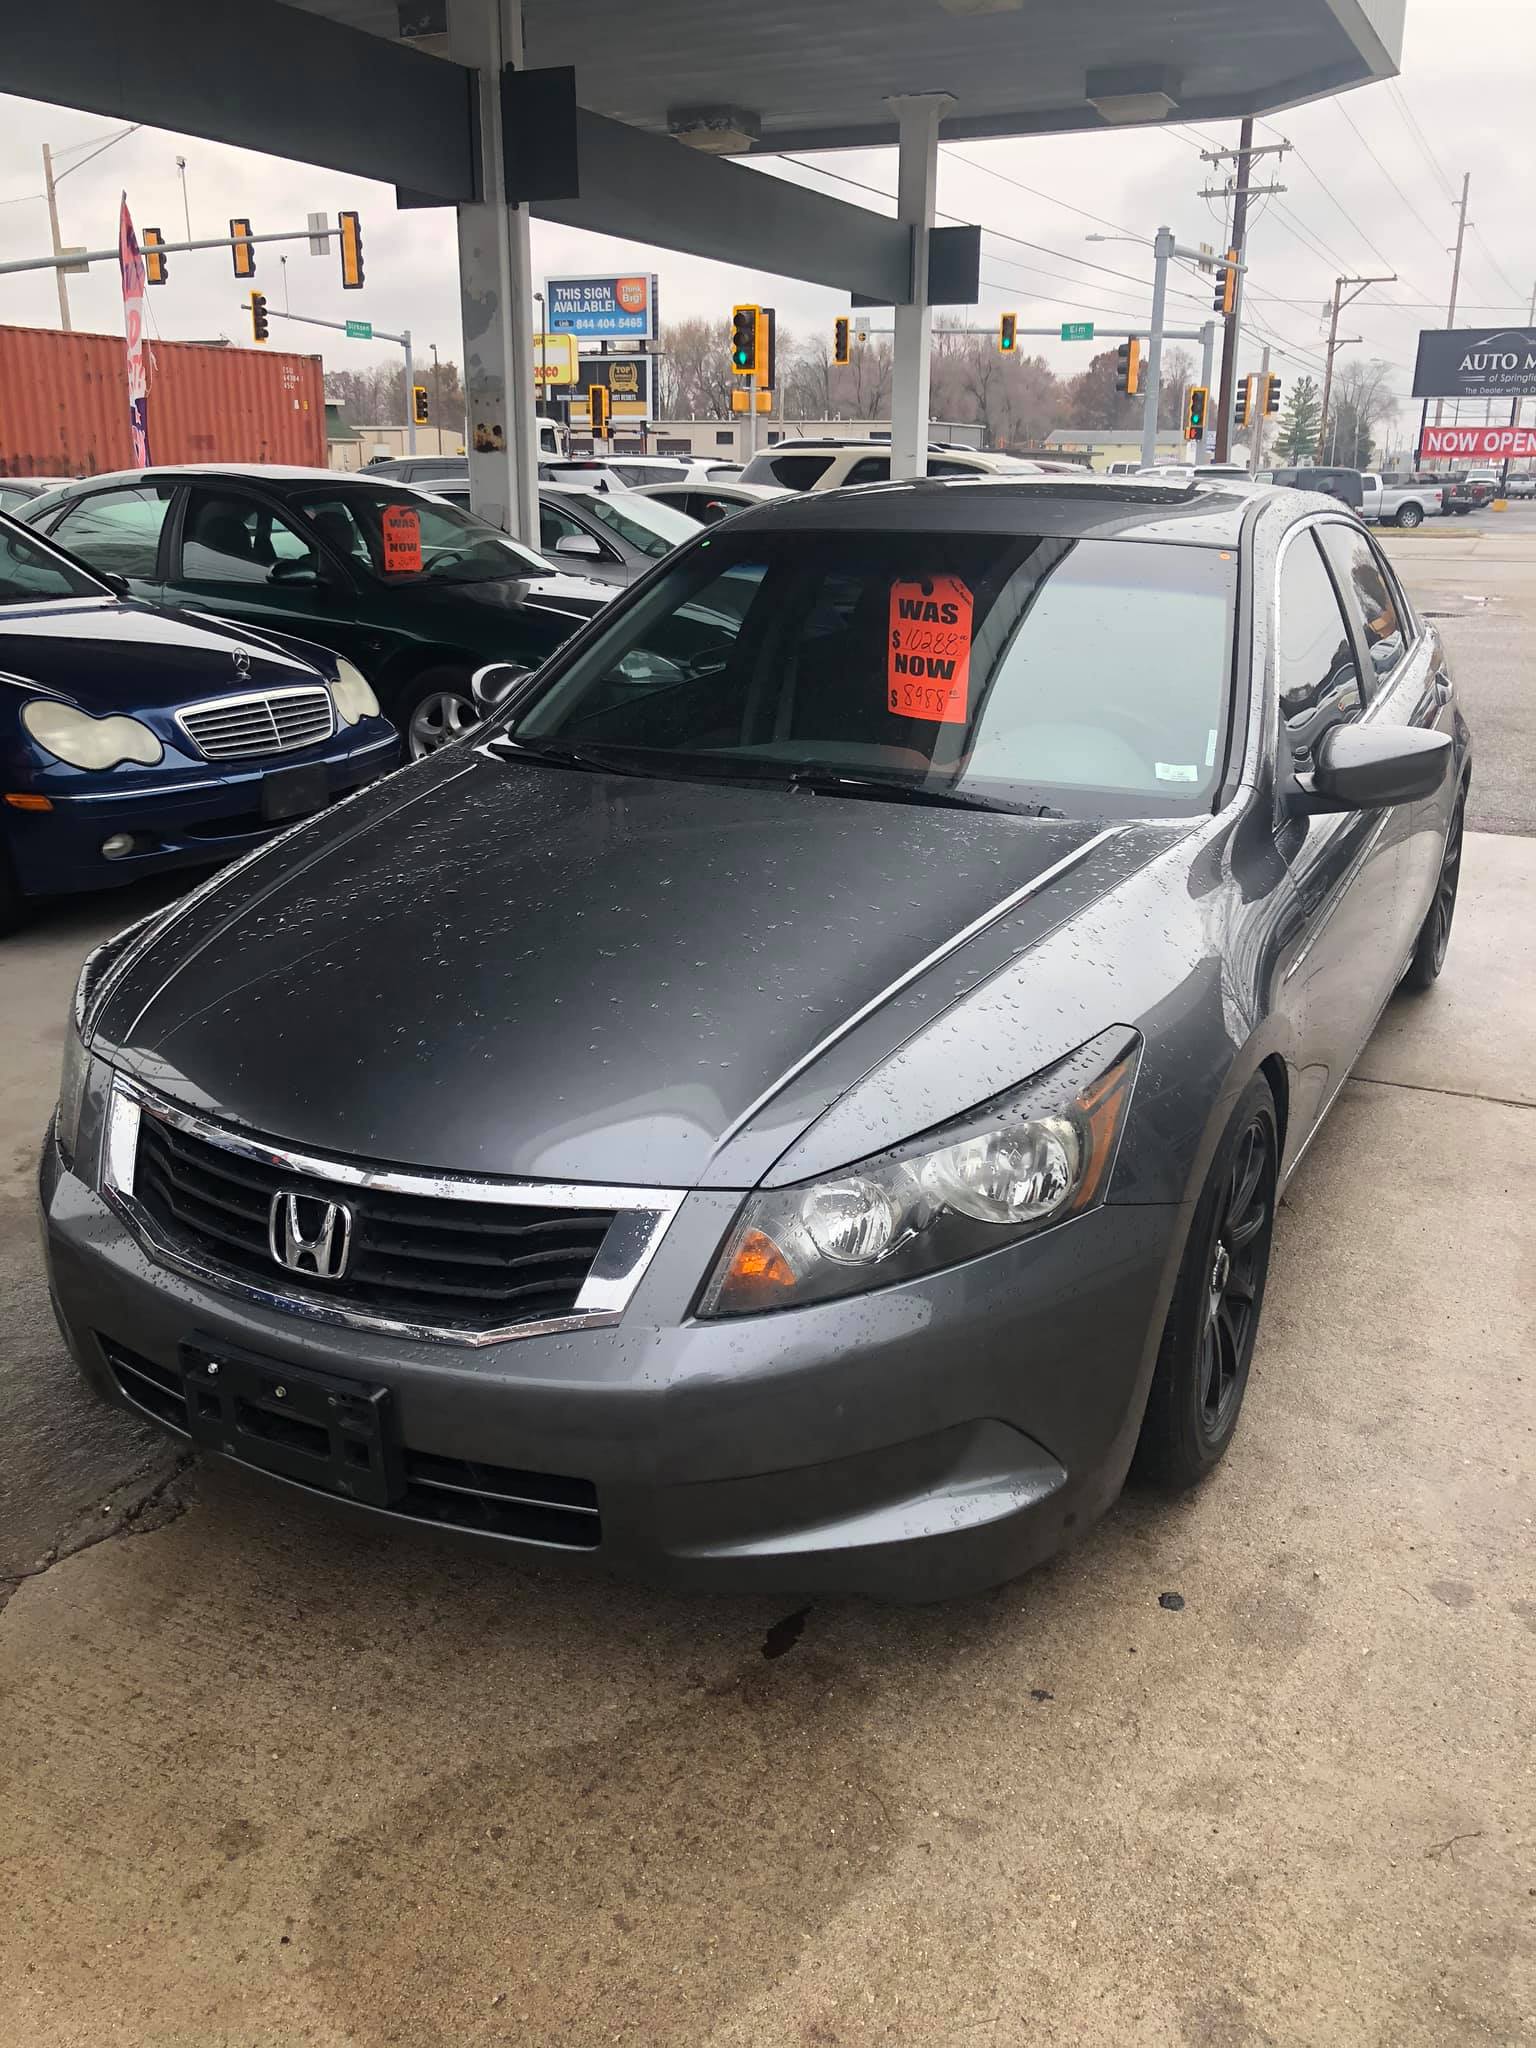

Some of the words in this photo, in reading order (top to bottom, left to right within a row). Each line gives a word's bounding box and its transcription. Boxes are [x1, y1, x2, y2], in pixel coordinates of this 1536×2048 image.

[556, 287, 582, 300] THIS
[584, 287, 611, 299] SIGN
[554, 300, 616, 313] AVAILABLE!
[576, 319, 594, 329] 844
[597, 318, 615, 329] 404
[1457, 353, 1518, 371] AUTO
[1489, 373, 1498, 383] of
[1480, 386, 1503, 394] Dealer
[1427, 431, 1479, 452] NOW
[1484, 431, 1536, 452] OPEN
[389, 519, 416, 528] WAS
[390, 543, 417, 552] NOW
[898, 598, 959, 625] WAS
[895, 653, 956, 680] NOW
